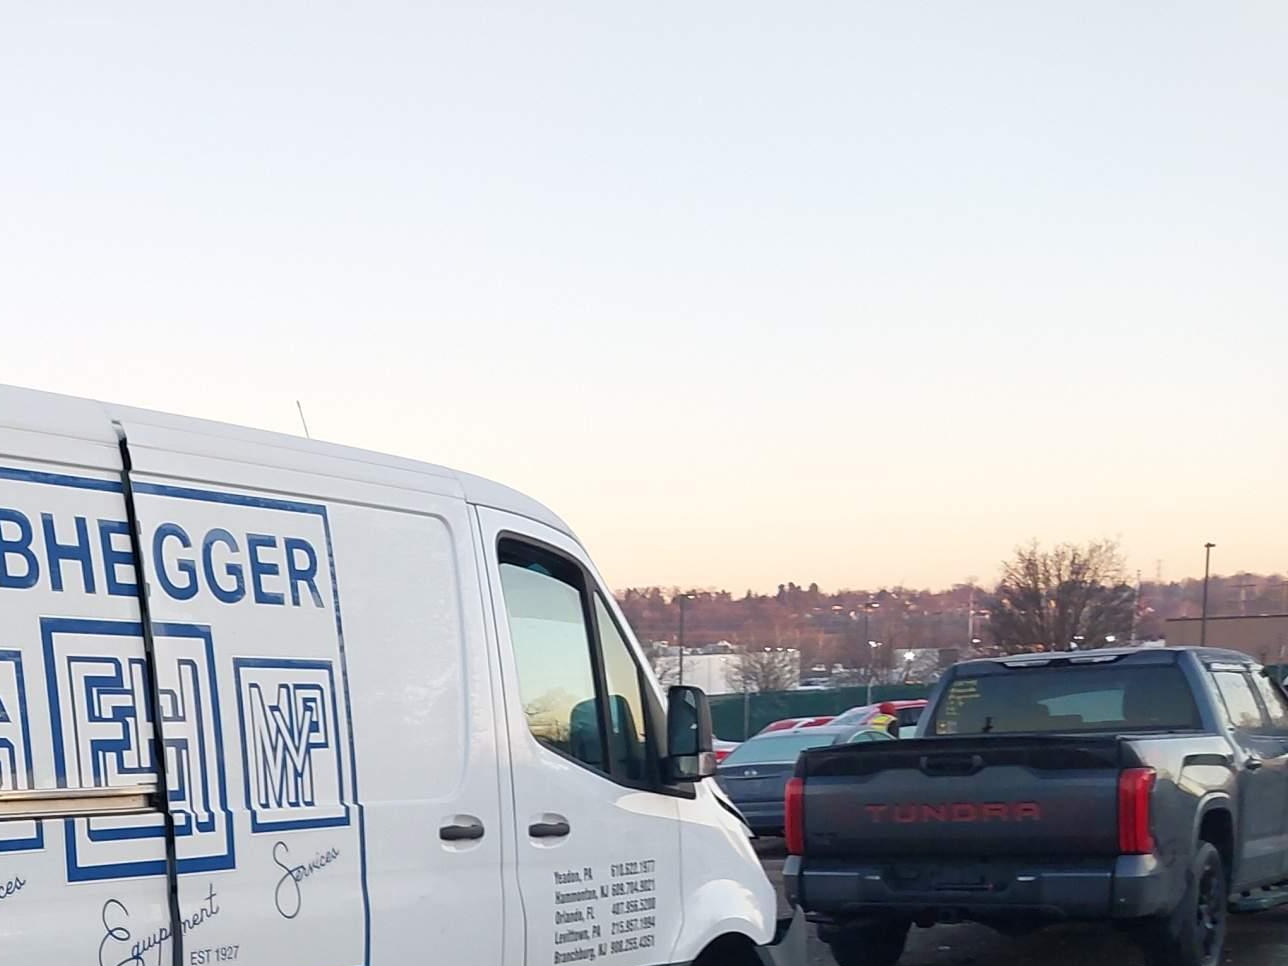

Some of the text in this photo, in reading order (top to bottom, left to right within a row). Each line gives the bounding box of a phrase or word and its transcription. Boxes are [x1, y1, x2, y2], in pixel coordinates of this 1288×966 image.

[864, 802, 1042, 823] TUNDRA
[273, 841, 340, 919] Services
[190, 944, 239, 966] EST 1927
